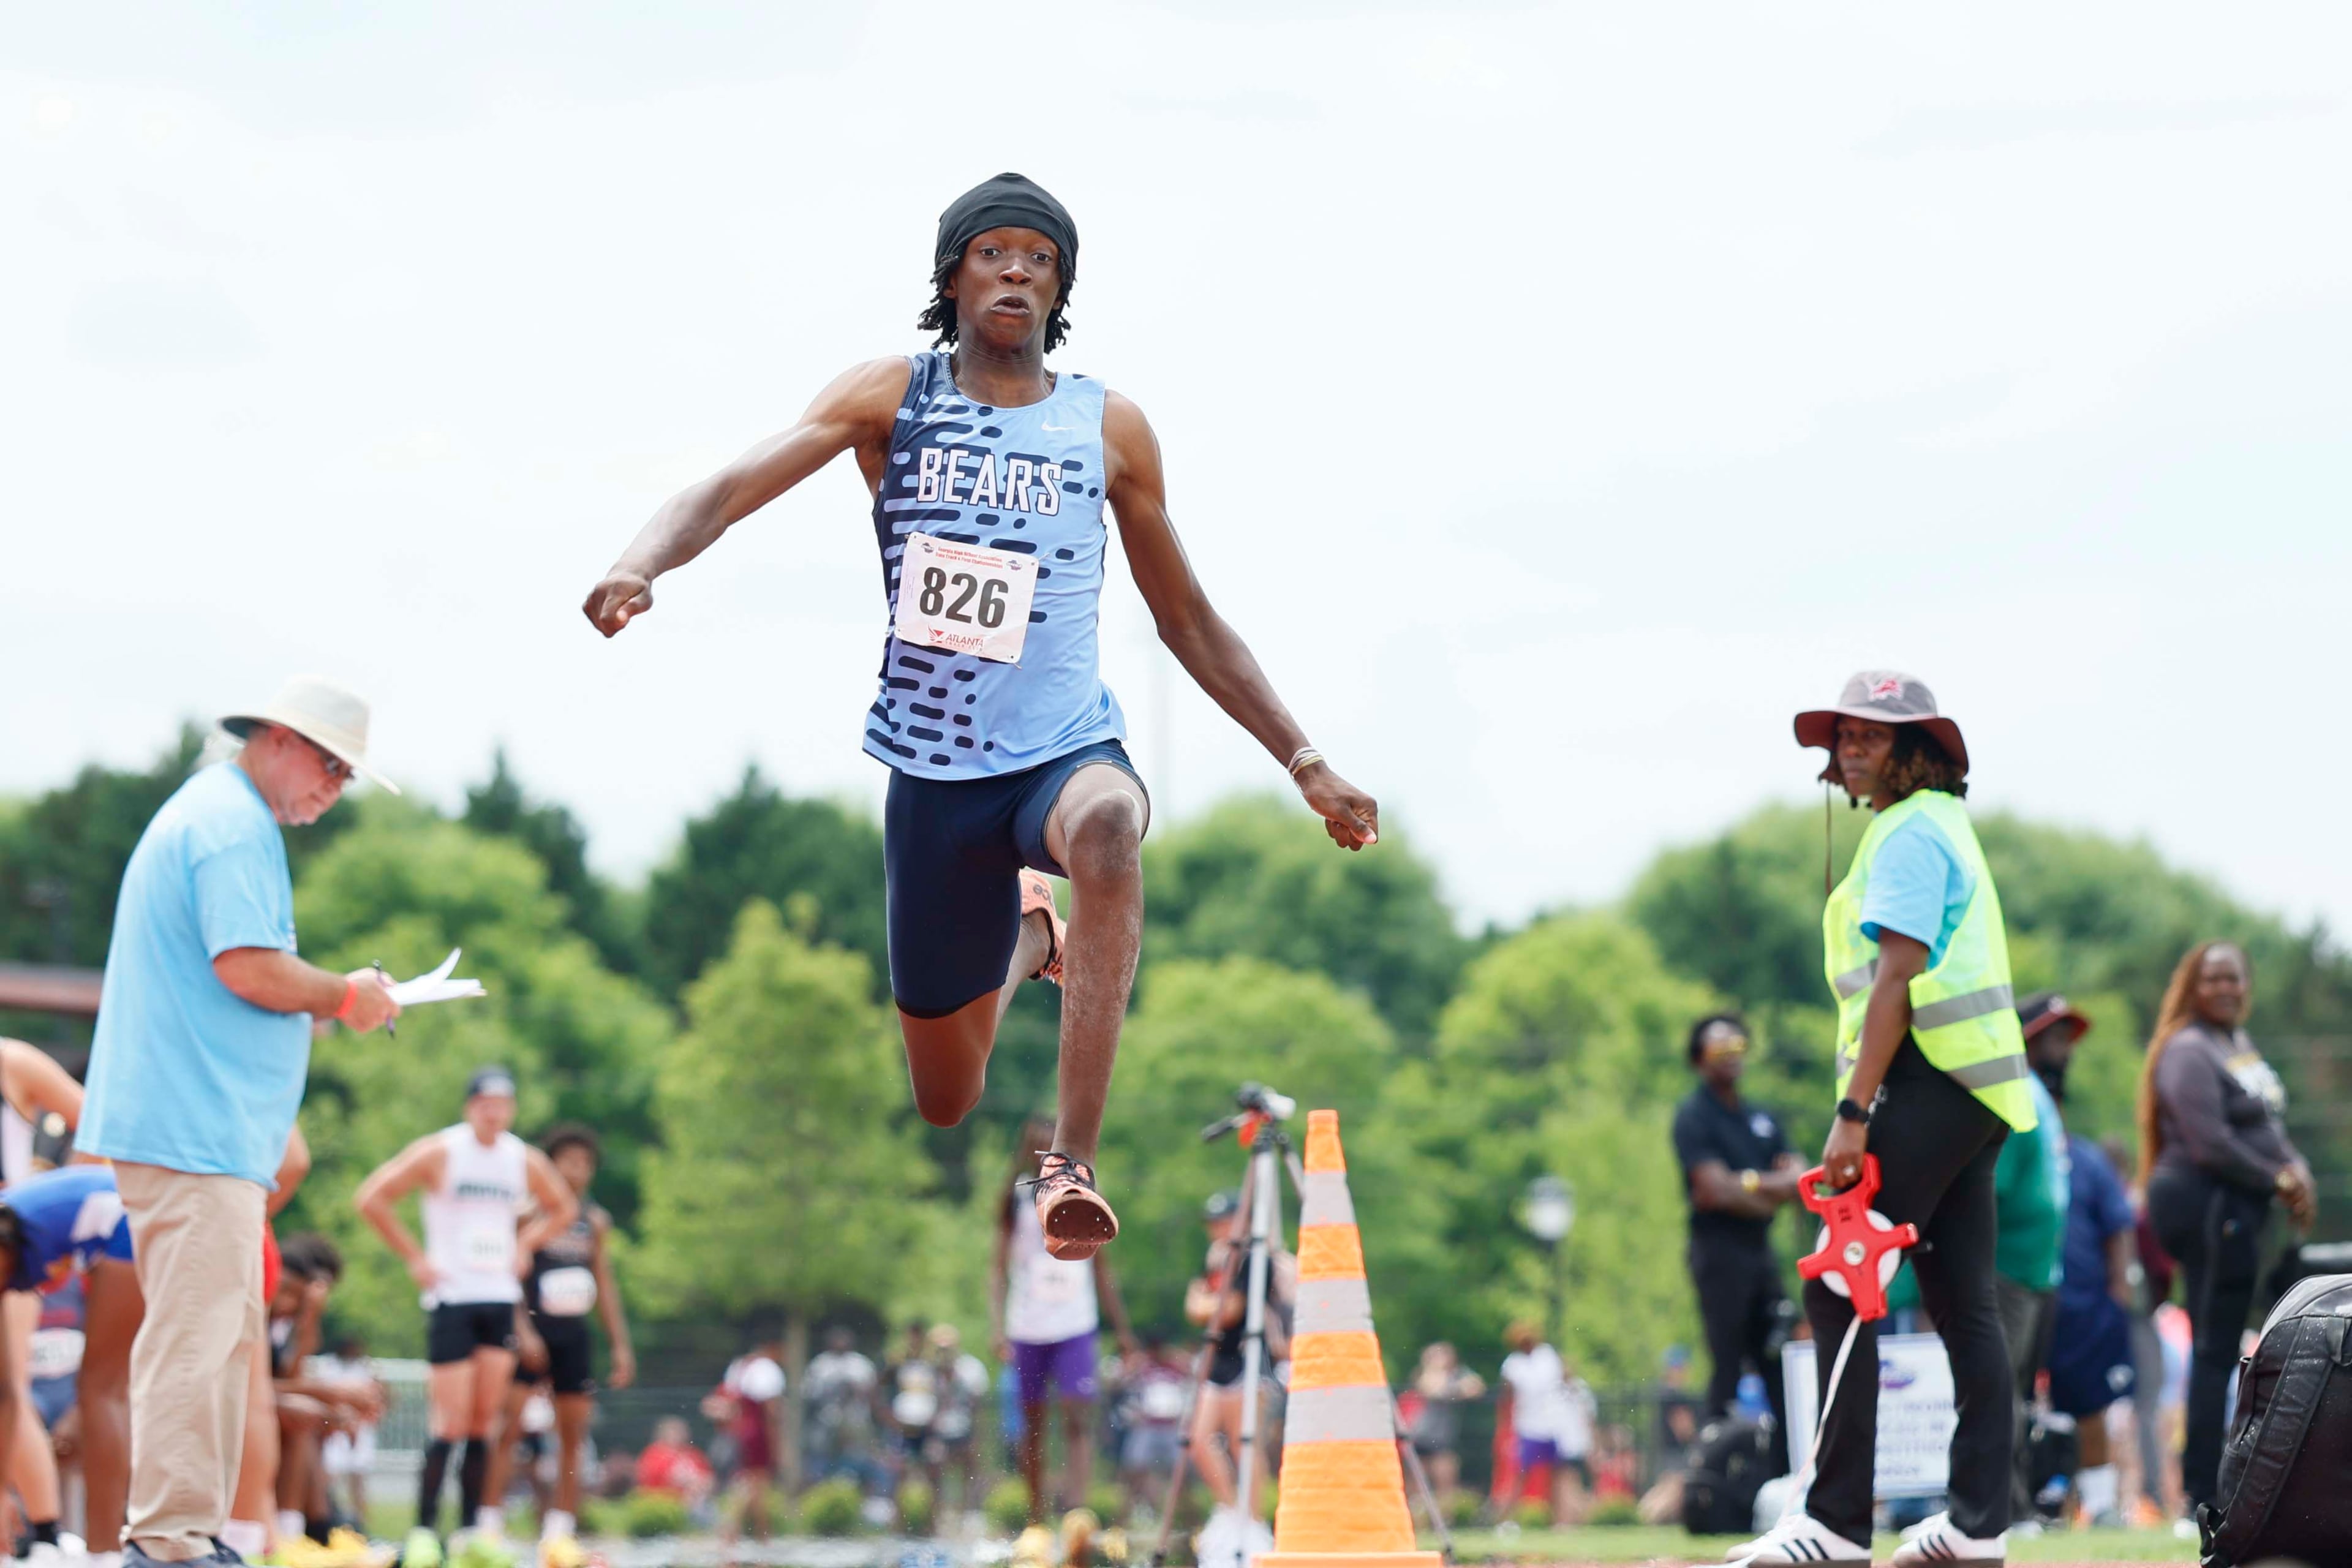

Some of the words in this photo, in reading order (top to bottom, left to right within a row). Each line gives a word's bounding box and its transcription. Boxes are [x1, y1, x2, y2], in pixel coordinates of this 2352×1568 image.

[917, 447, 1062, 516] BEARS
[919, 567, 1009, 628] 826
[946, 634, 983, 647] ATLANTA
